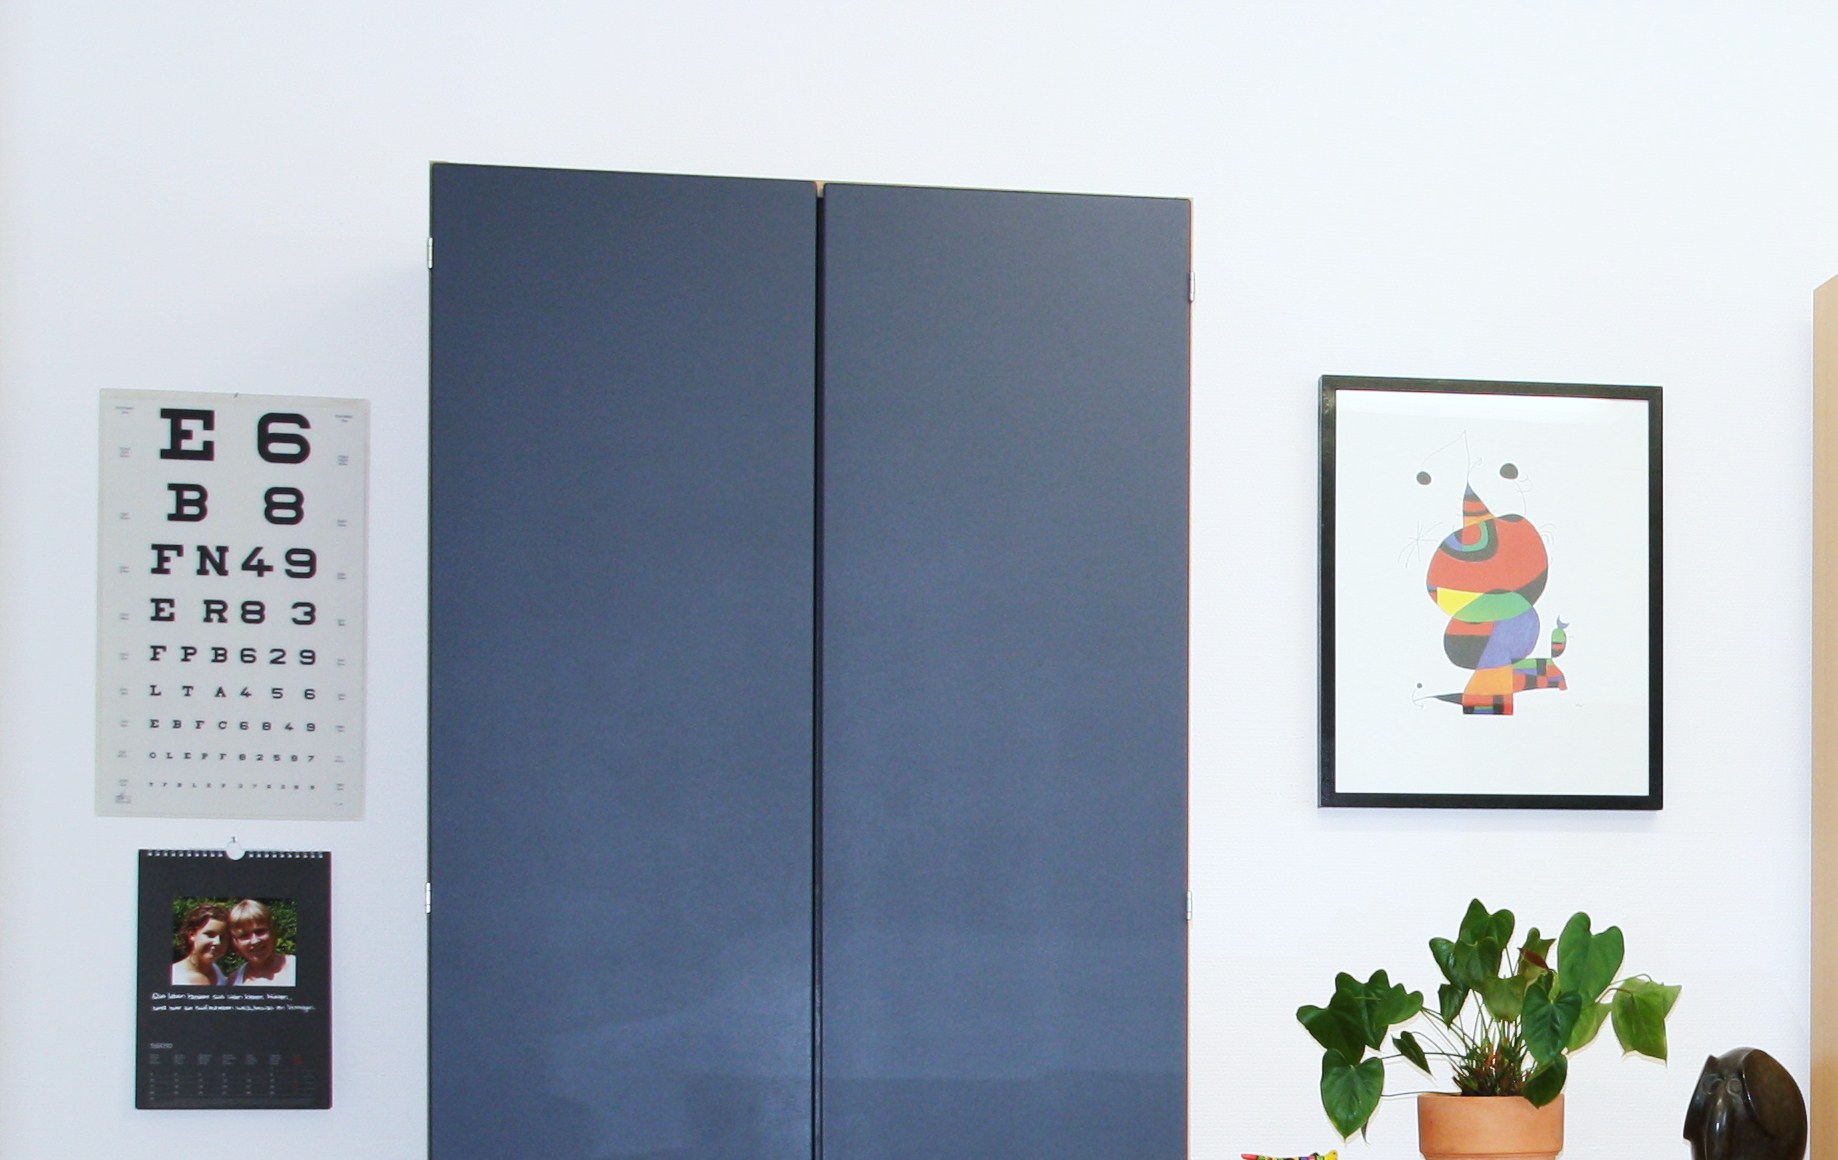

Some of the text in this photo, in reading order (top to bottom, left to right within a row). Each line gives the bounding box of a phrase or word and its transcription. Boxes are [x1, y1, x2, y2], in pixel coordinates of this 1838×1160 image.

[160, 408, 311, 464] E 6
[167, 483, 304, 525] B 8
[151, 544, 317, 579] F N 4 9
[150, 598, 316, 626] E R 8 3
[150, 645, 316, 665] F P B 6 2 9
